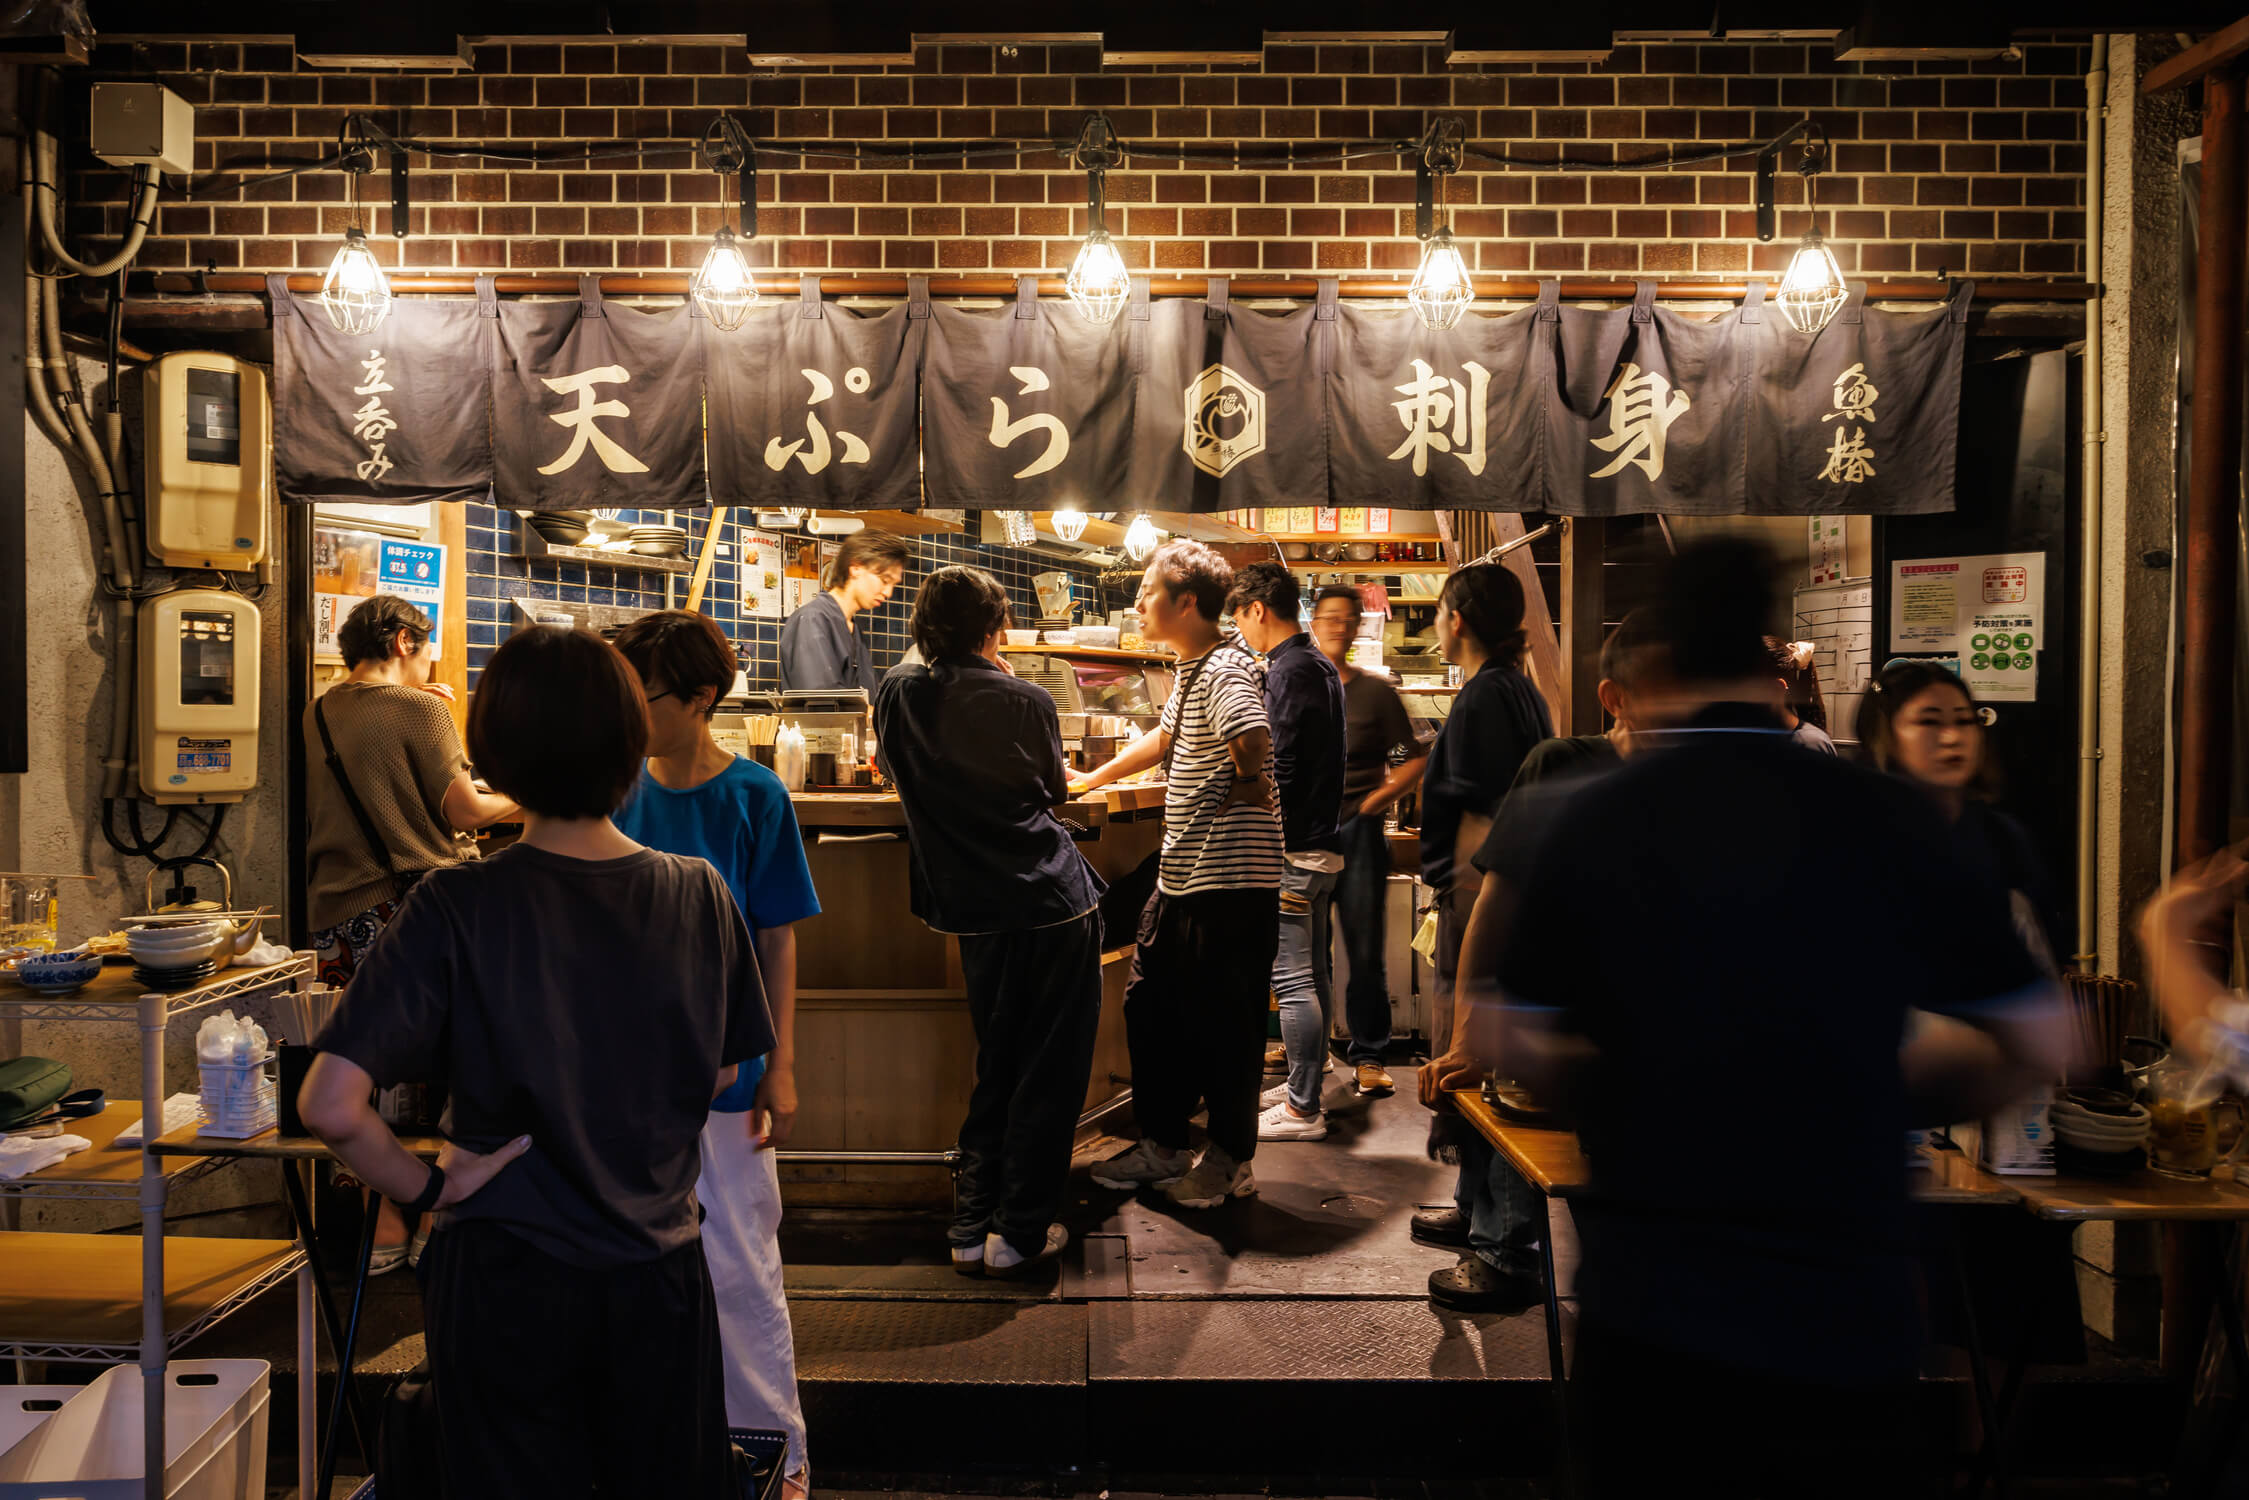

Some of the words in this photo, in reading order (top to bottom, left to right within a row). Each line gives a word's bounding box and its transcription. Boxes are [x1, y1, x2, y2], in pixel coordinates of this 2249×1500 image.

[352, 350, 397, 481] 立呑み
[536, 364, 1070, 479] 天ぷら
[1387, 358, 1691, 481] 刺身
[1817, 363, 1880, 484] 魚椿
